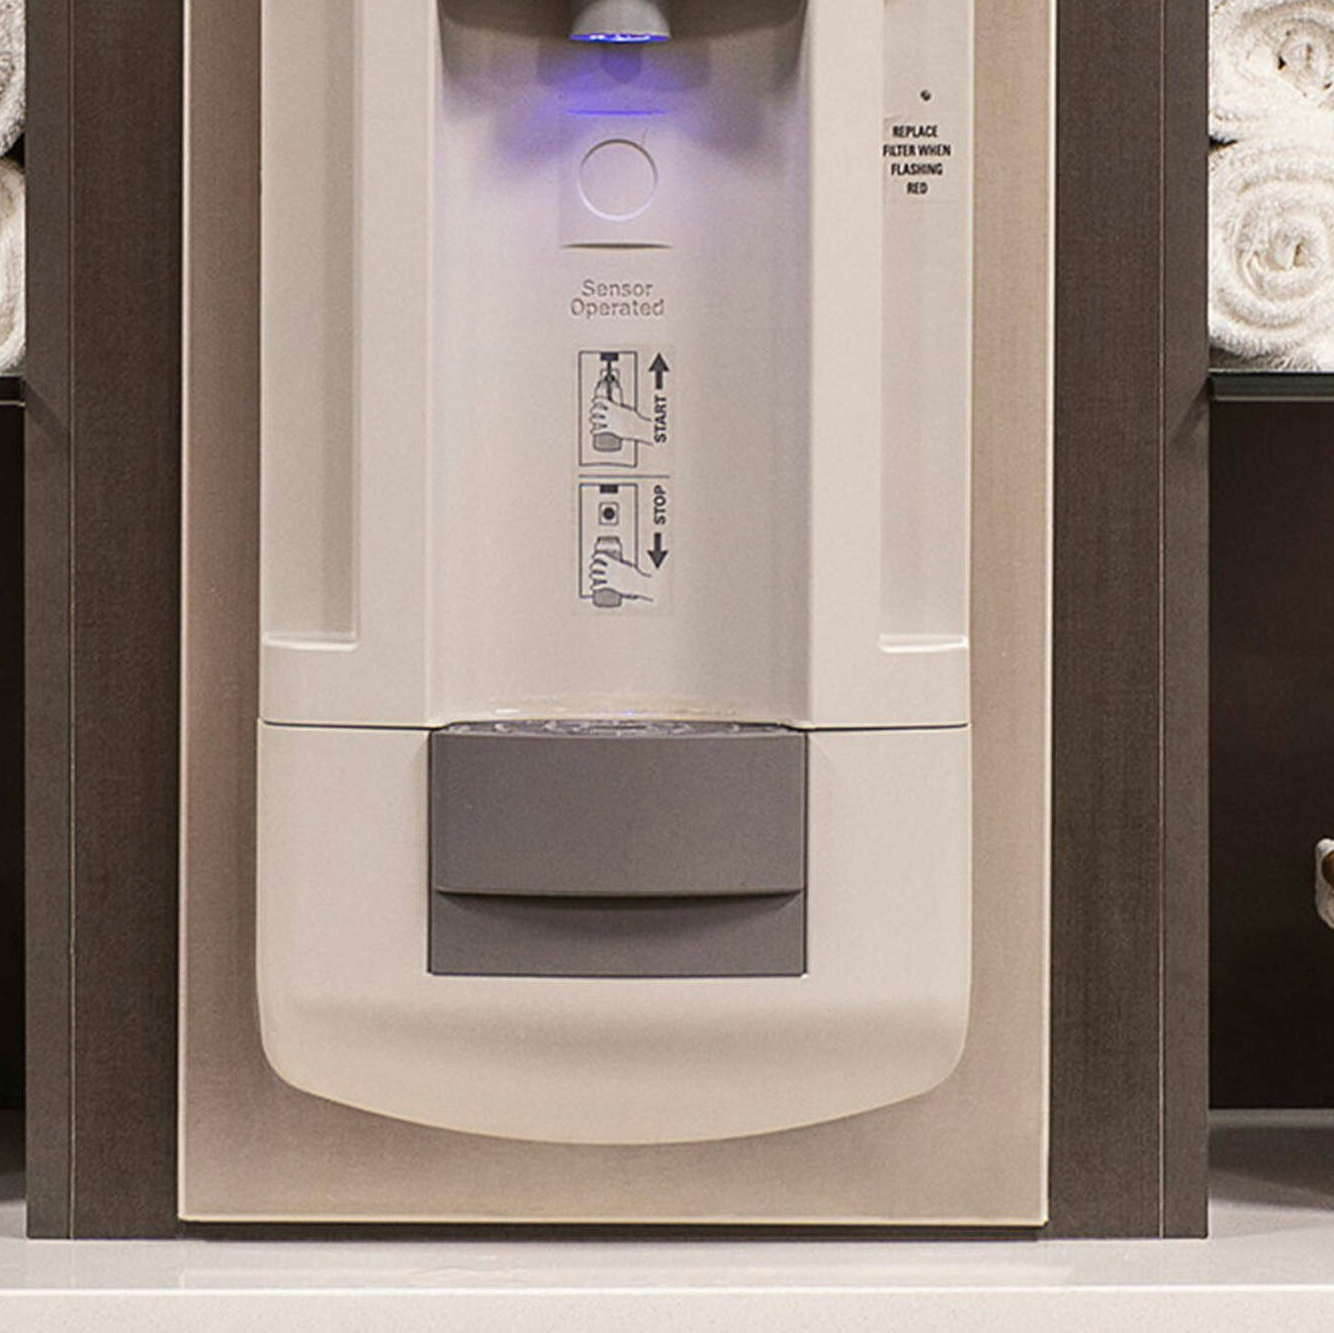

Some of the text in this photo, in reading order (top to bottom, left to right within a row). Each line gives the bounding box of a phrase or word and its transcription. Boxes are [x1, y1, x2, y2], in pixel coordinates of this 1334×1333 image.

[892, 125, 938, 138] REPLACE
[882, 144, 952, 157] FILTER WHEN
[890, 162, 944, 176] FLASHING
[906, 181, 929, 195] RED
[581, 278, 654, 298] Sensor
[570, 297, 665, 319] Operated
[654, 395, 667, 444] START
[653, 484, 667, 526] STOP
